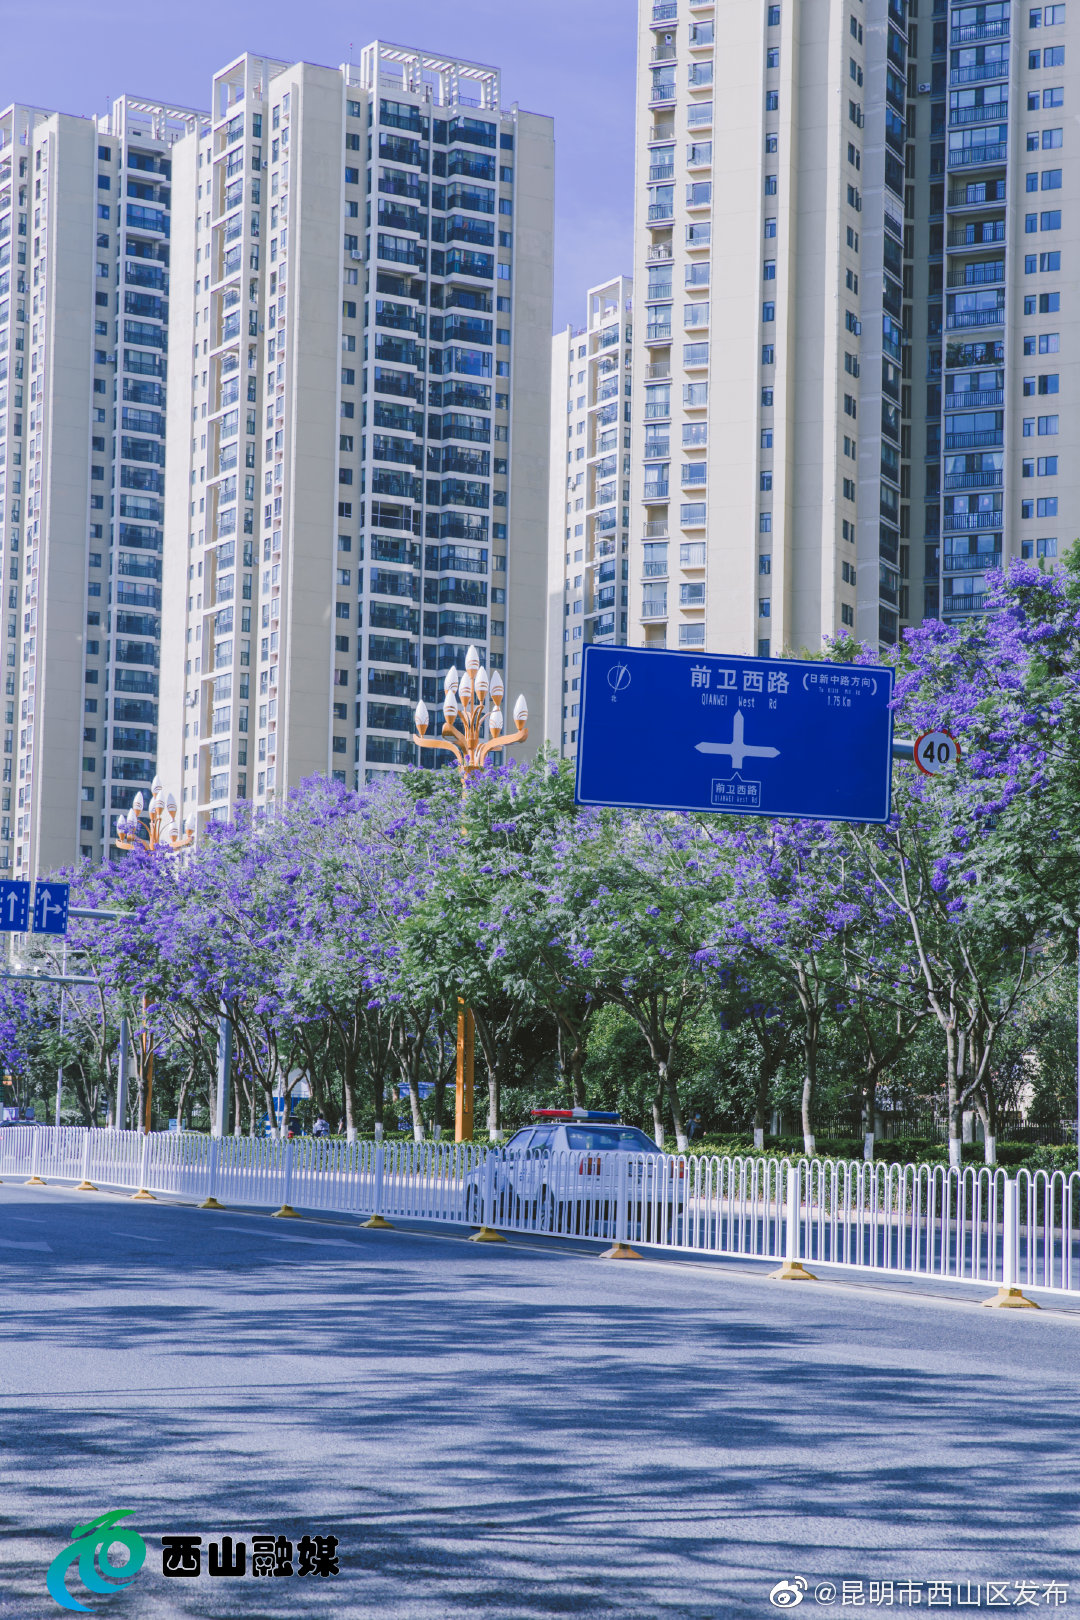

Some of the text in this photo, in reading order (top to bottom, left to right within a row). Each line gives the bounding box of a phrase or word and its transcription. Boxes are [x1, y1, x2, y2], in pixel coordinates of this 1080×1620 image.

[690, 664, 790, 694] 前卫西路
[701, 693, 777, 710] QIANWEI West Rd
[923, 741, 950, 764] 40
[715, 782, 758, 796] 前卫西路
